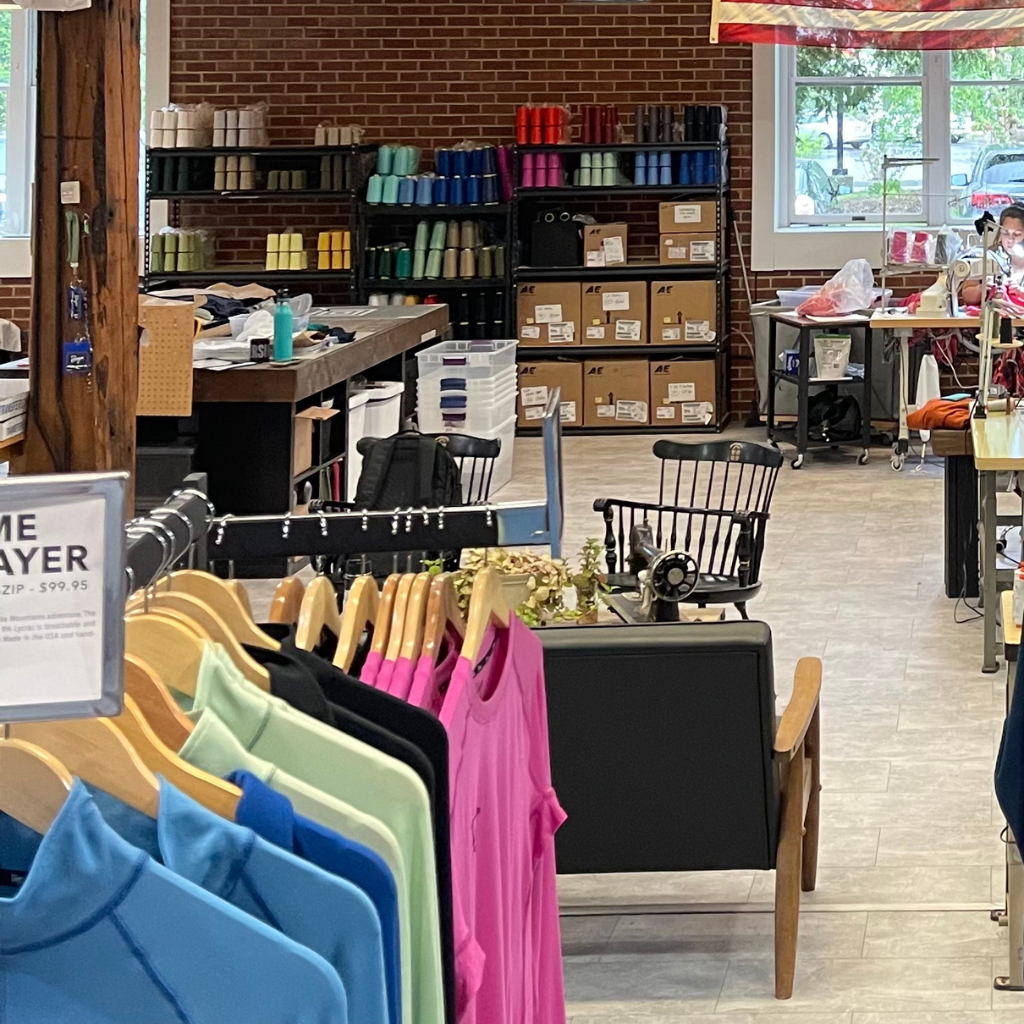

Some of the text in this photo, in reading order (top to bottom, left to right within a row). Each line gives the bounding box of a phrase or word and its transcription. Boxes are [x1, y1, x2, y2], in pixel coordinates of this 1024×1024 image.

[520, 286, 536, 294] AE
[585, 286, 602, 294] AE
[657, 286, 673, 294] AE
[520, 367, 537, 375] AE
[588, 367, 604, 375] AE
[654, 365, 671, 373] AE
[39, 579, 88, 594] $99.95
